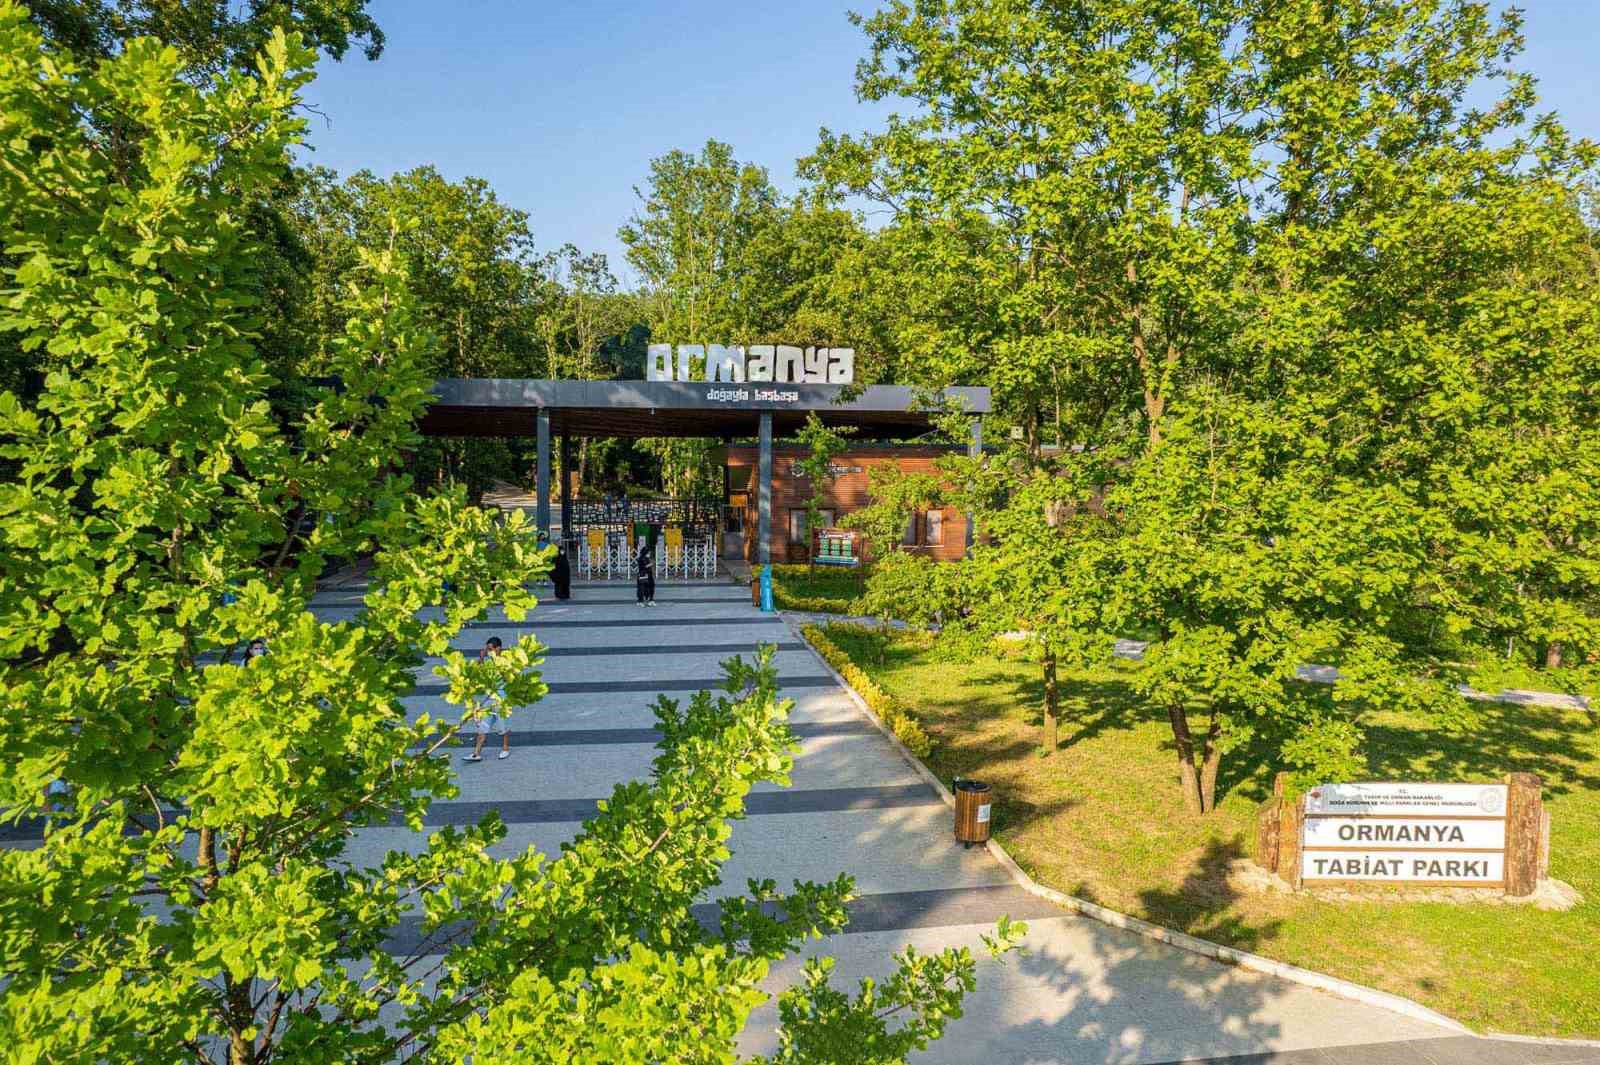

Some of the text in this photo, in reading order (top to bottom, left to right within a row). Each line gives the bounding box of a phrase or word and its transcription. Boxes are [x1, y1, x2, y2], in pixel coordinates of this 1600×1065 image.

[707, 388, 749, 402] doğayla
[1338, 824, 1465, 842] ORMANYA
[1314, 856, 1489, 878] TABİAT PARKI
